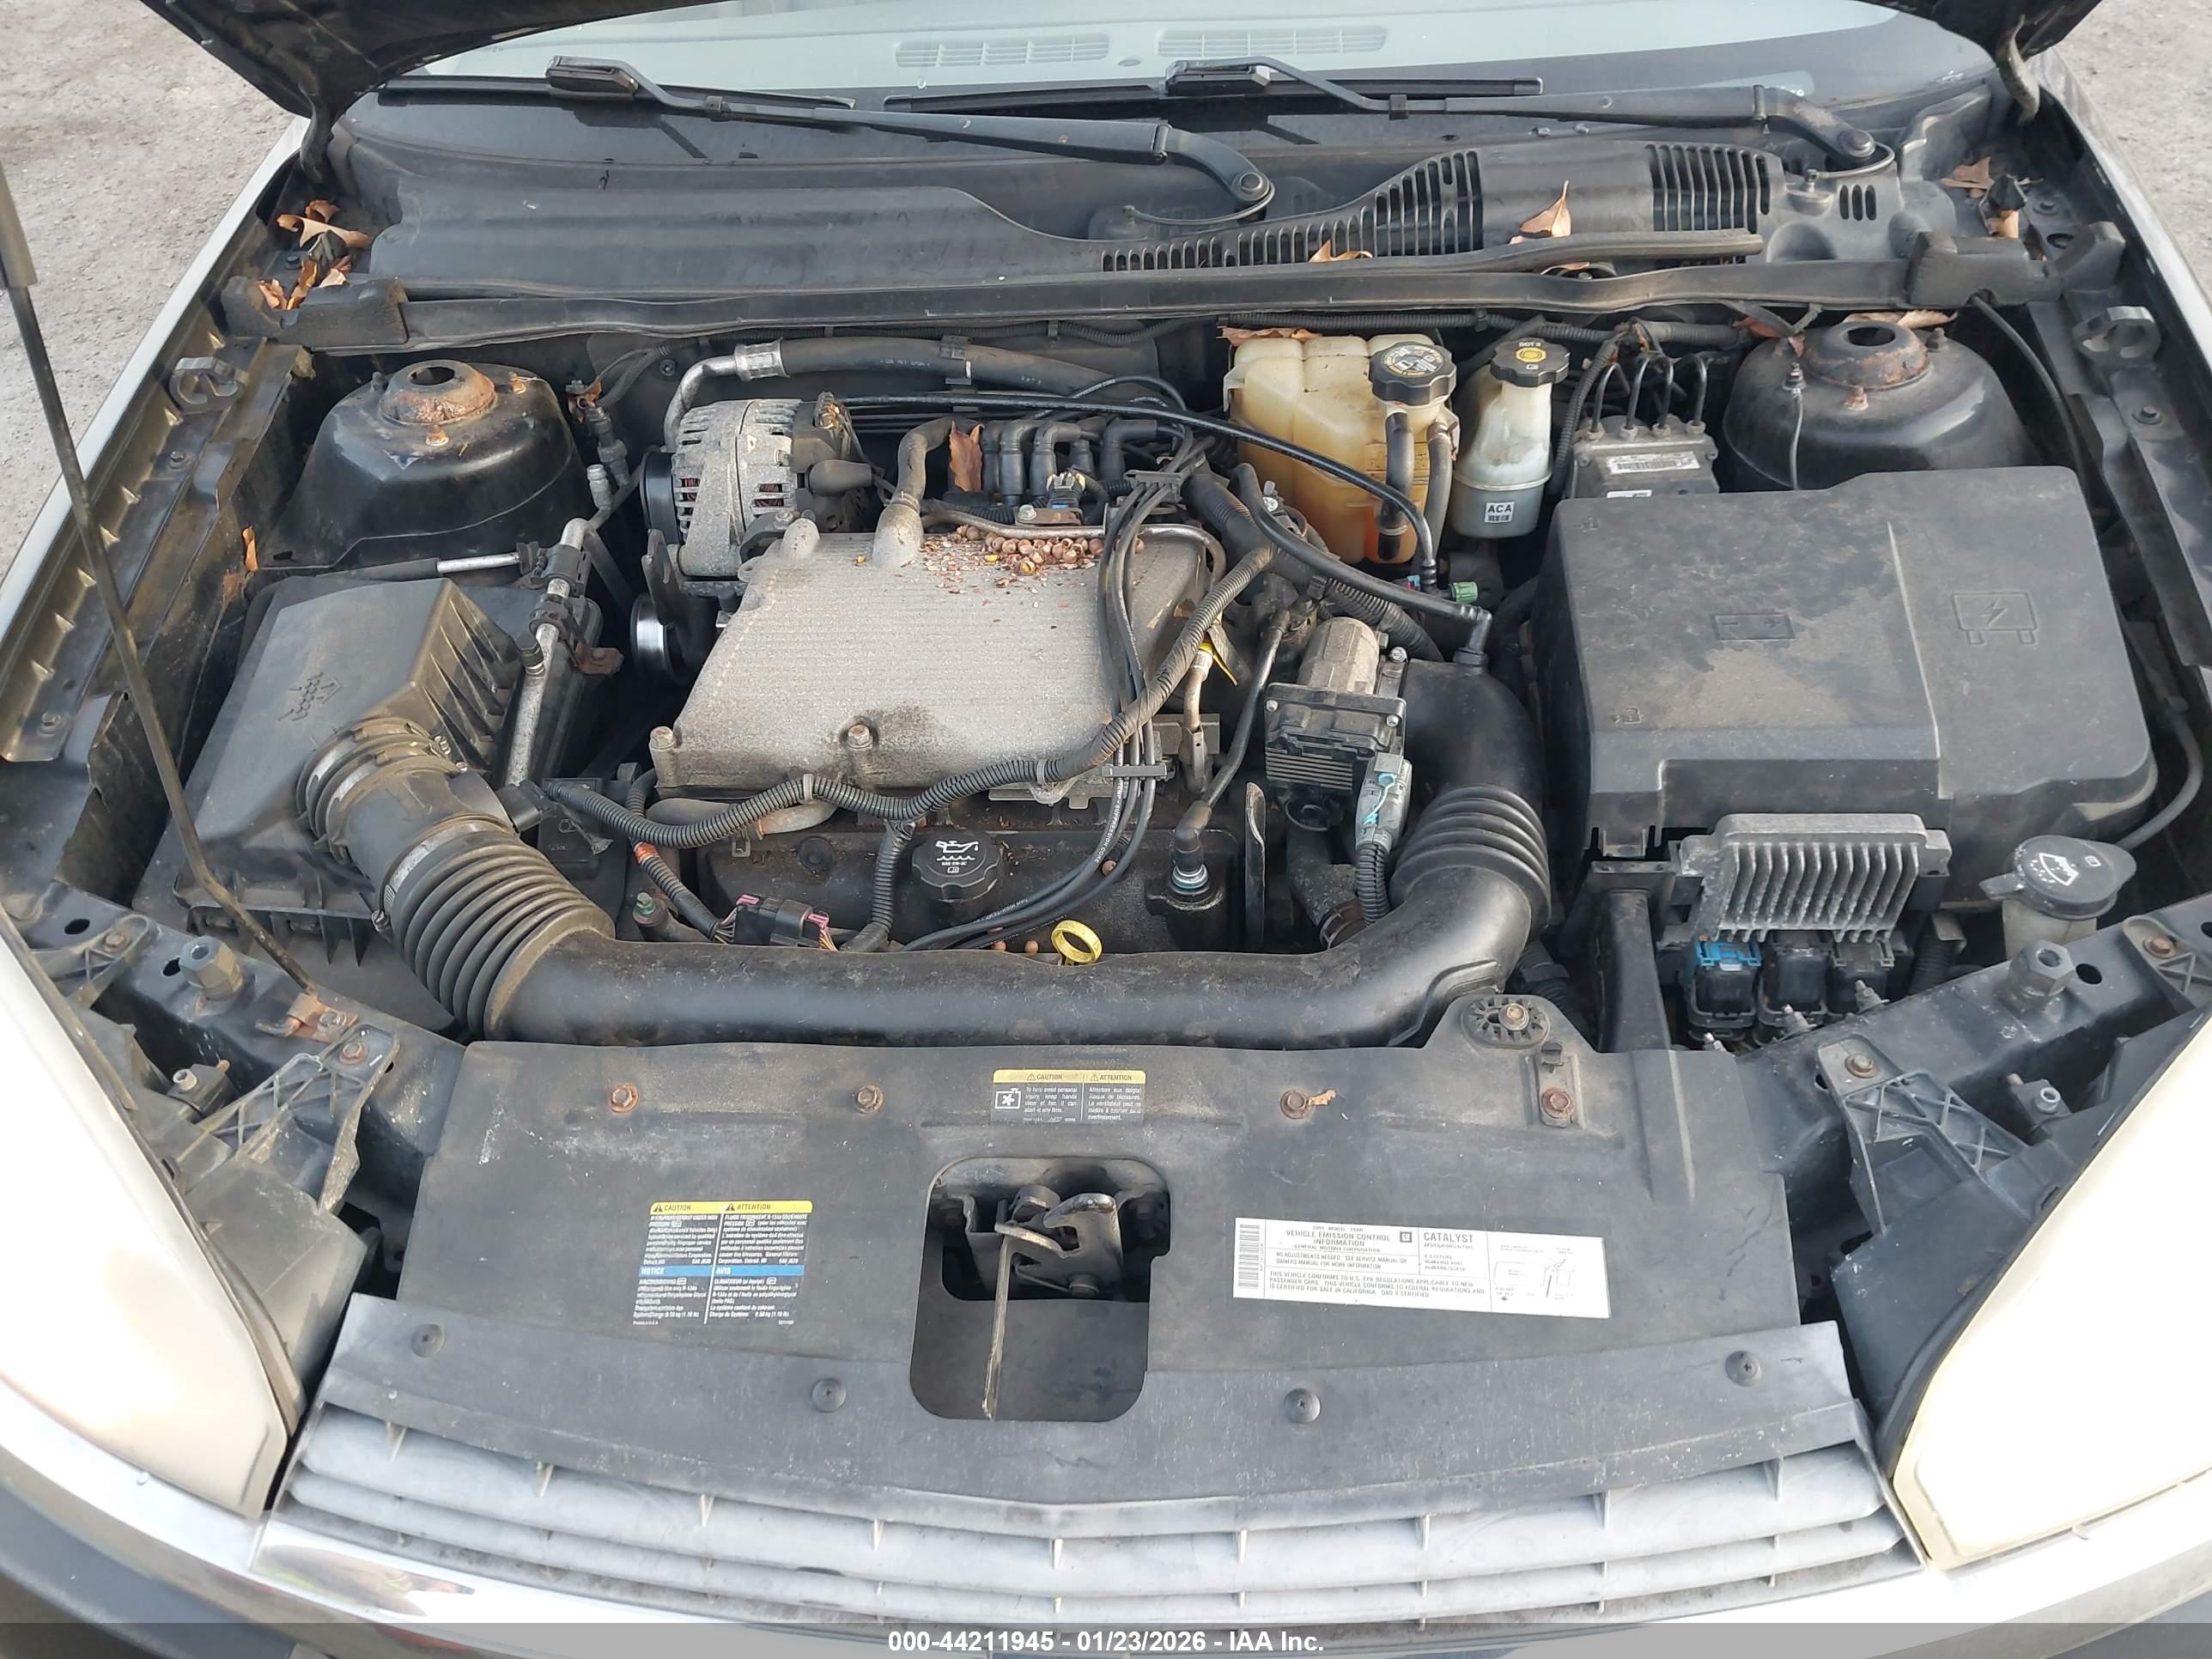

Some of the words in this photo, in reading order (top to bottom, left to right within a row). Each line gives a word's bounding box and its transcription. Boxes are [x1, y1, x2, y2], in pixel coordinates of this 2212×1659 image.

[1487, 504, 1512, 514] ACA
[1094, 847, 1106, 864] CORE
[1319, 1231, 1354, 1240] EMISSION
[1357, 1233, 1391, 1242] CONTROL
[1424, 1231, 1474, 1243] CATALYST
[1314, 1238, 1365, 1247] INFORMATION
